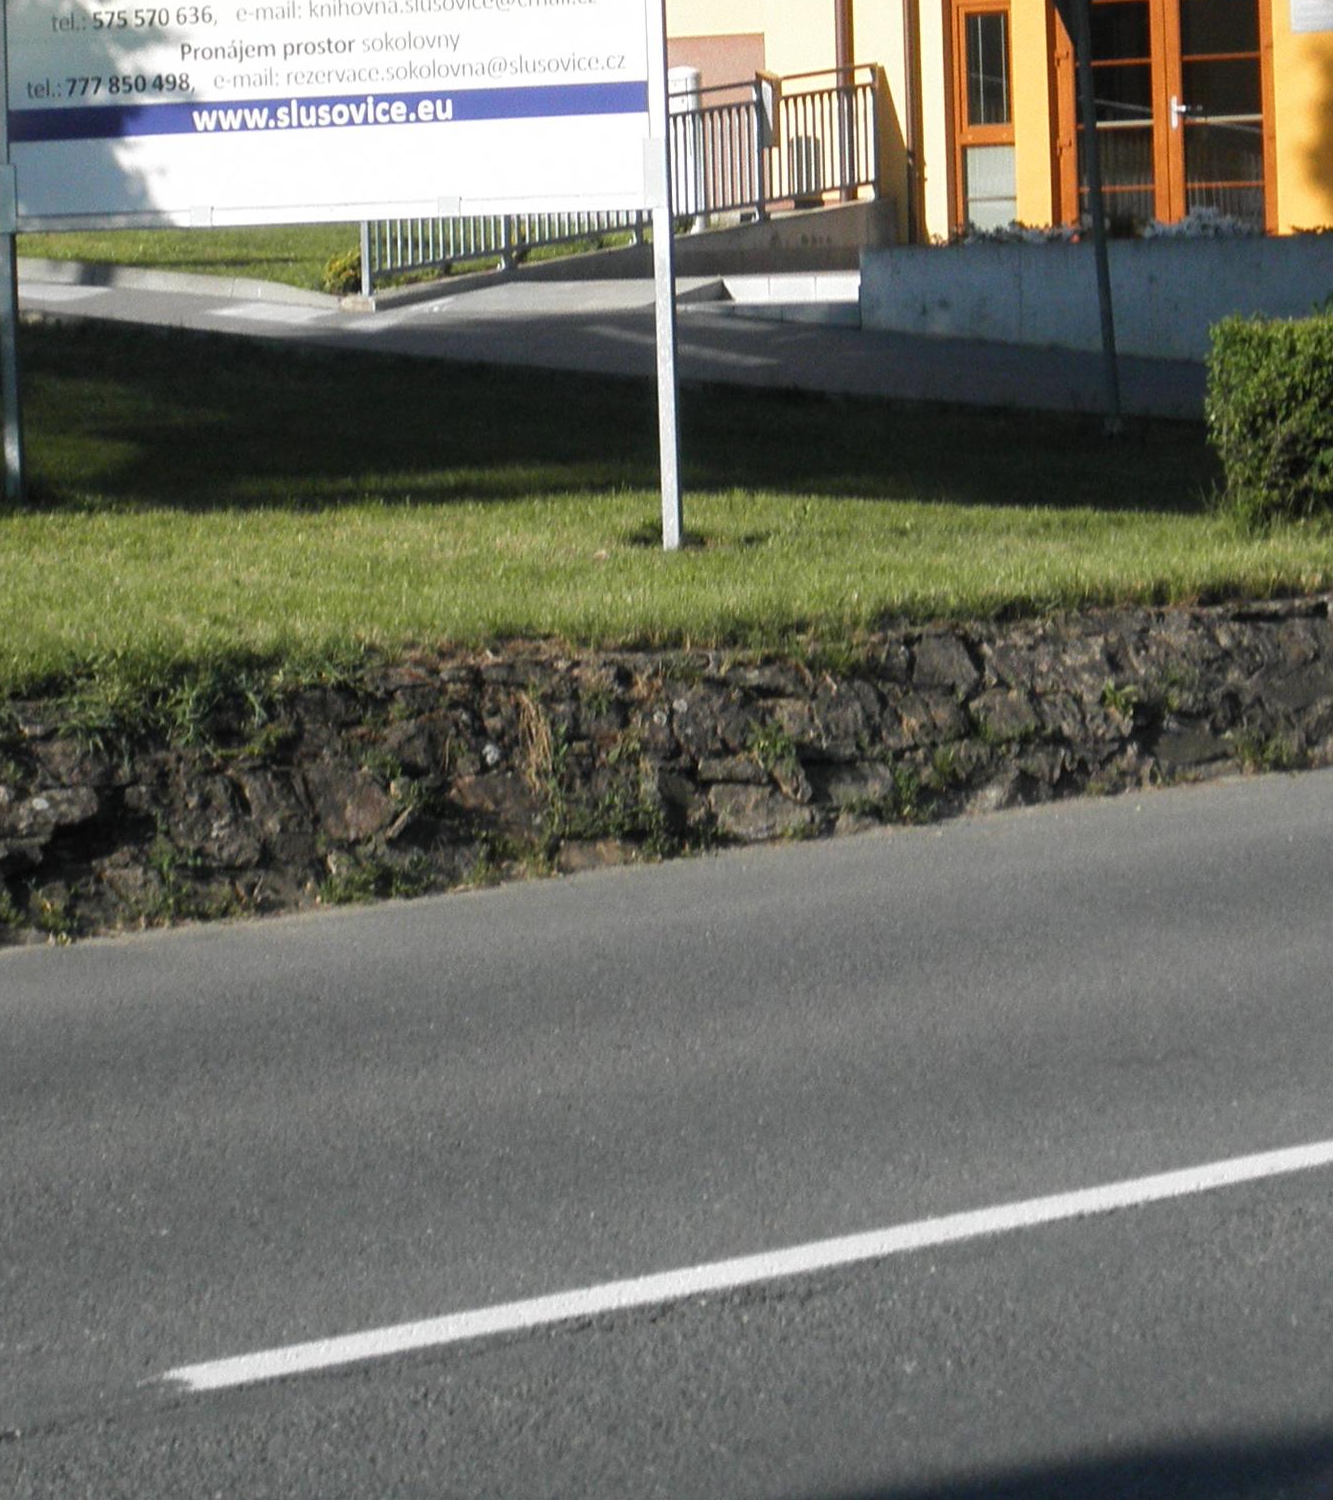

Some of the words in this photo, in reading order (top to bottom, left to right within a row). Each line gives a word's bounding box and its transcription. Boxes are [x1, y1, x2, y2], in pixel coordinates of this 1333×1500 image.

[51, 11, 87, 32] tel.:
[92, 10, 128, 31] 575
[134, 7, 170, 28] 570
[175, 5, 218, 27] 636,
[180, 39, 276, 64] Pronájem
[282, 36, 356, 61] prostor
[361, 31, 461, 54] sokolovny
[26, 80, 62, 99] tel.:
[66, 77, 102, 97] 777
[107, 75, 147, 96] 850
[151, 72, 196, 94] 498,
[213, 67, 280, 90] e-mail:
[285, 52, 627, 87] rezervace.sokolovna@slusovice.cz
[192, 95, 454, 132] www.slusovice.eu
